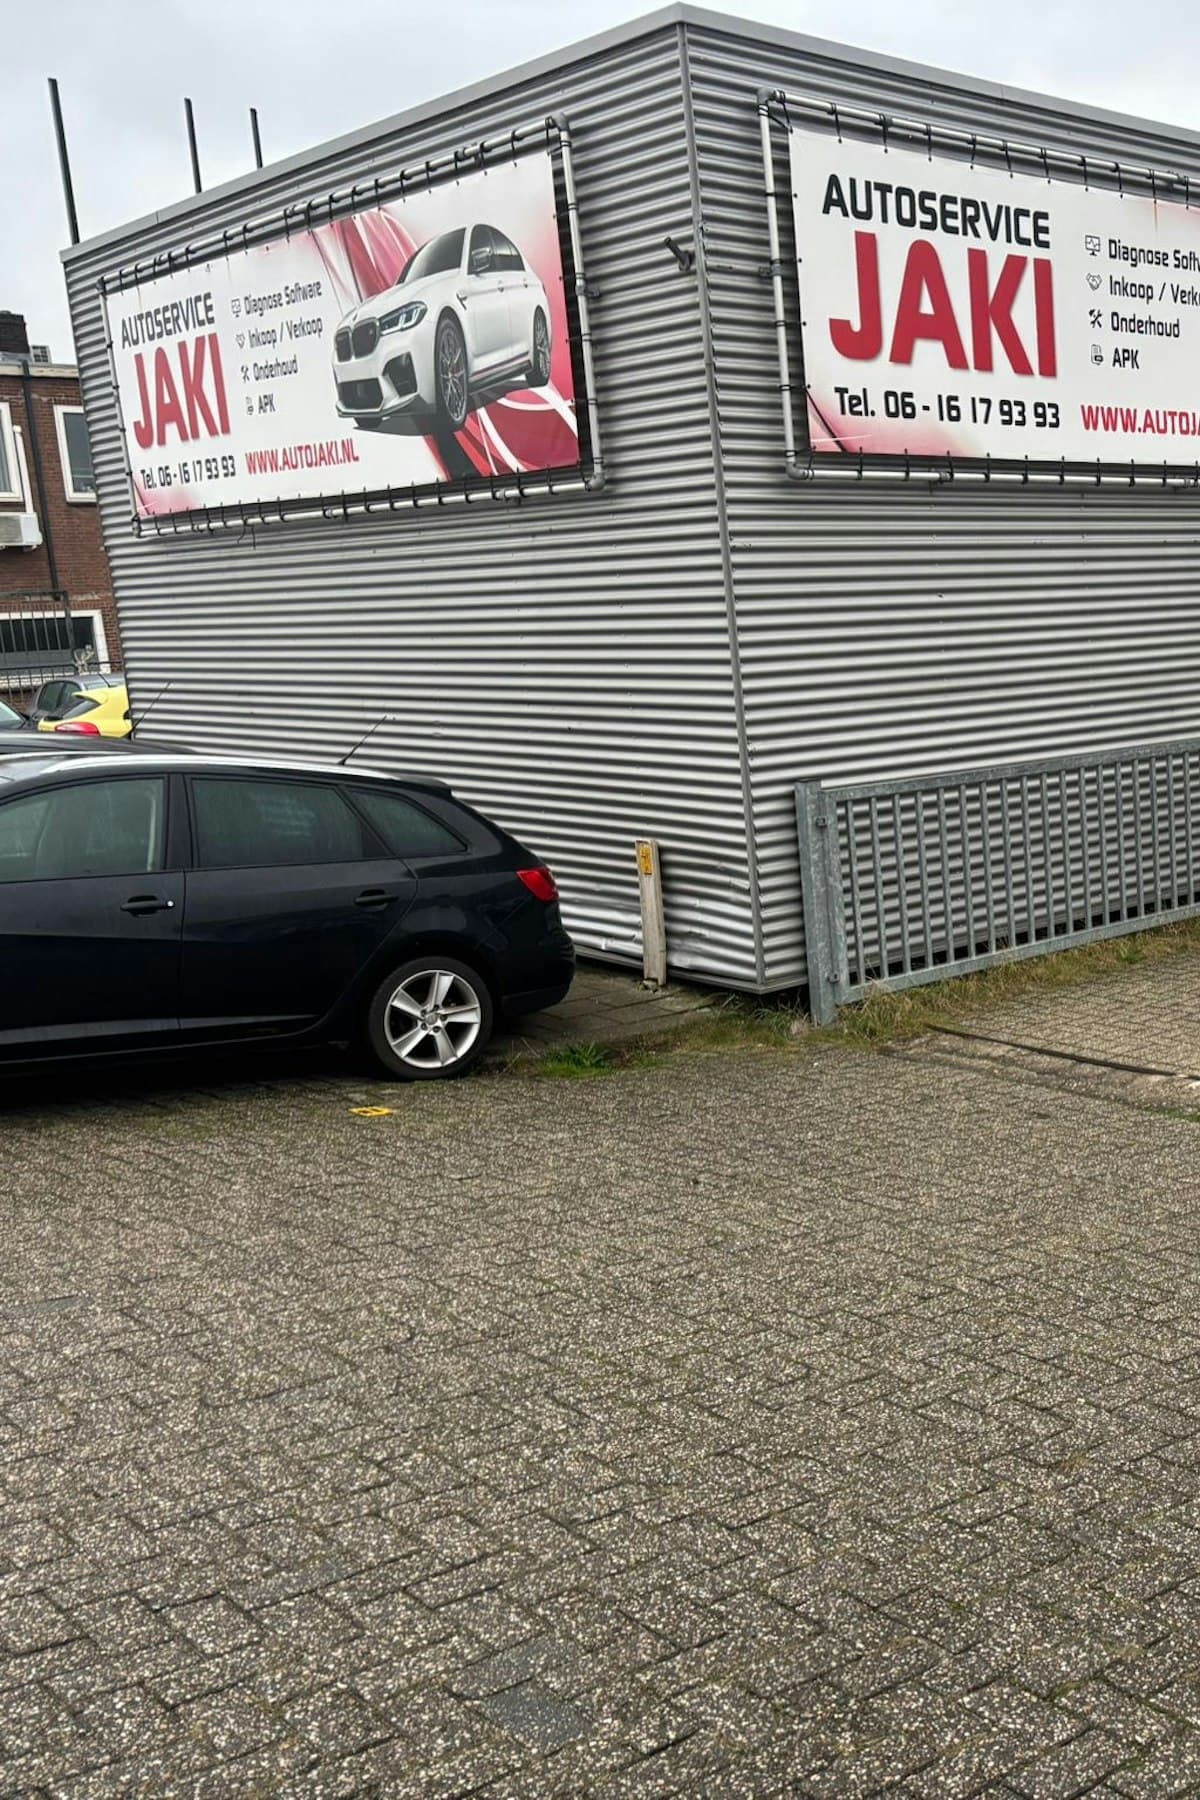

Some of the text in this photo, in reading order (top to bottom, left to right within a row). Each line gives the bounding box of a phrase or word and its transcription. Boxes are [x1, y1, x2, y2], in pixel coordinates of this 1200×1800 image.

[822, 173, 1051, 249] AUTOSERVICE
[1108, 238, 1169, 268] Diagnose
[244, 281, 323, 317] Diagnose Software
[828, 230, 1057, 378] JAKI
[1109, 274, 1154, 305] Inkoop
[1158, 281, 1167, 302] /
[121, 292, 214, 348] AUTOSERVICE
[248, 317, 323, 349] Inkoop / Verkoop
[1111, 311, 1180, 338] Onderhoud
[252, 354, 298, 381] Onderhoud
[1112, 347, 1139, 370] APK
[133, 332, 230, 448] JAKI
[258, 393, 276, 414] APK
[834, 386, 876, 417] Tel.
[884, 390, 916, 419] 06
[938, 394, 961, 422] 16
[971, 396, 992, 425] 17
[1000, 399, 1026, 427] 93
[1035, 402, 1060, 429] 93
[141, 468, 157, 490] Tel.
[159, 465, 172, 487] 06
[179, 460, 190, 485] 16
[192, 459, 202, 482] 17
[206, 458, 219, 479] 93
[221, 455, 235, 477] 93
[245, 438, 359, 474] WWW.AUTOJAKI.NL
